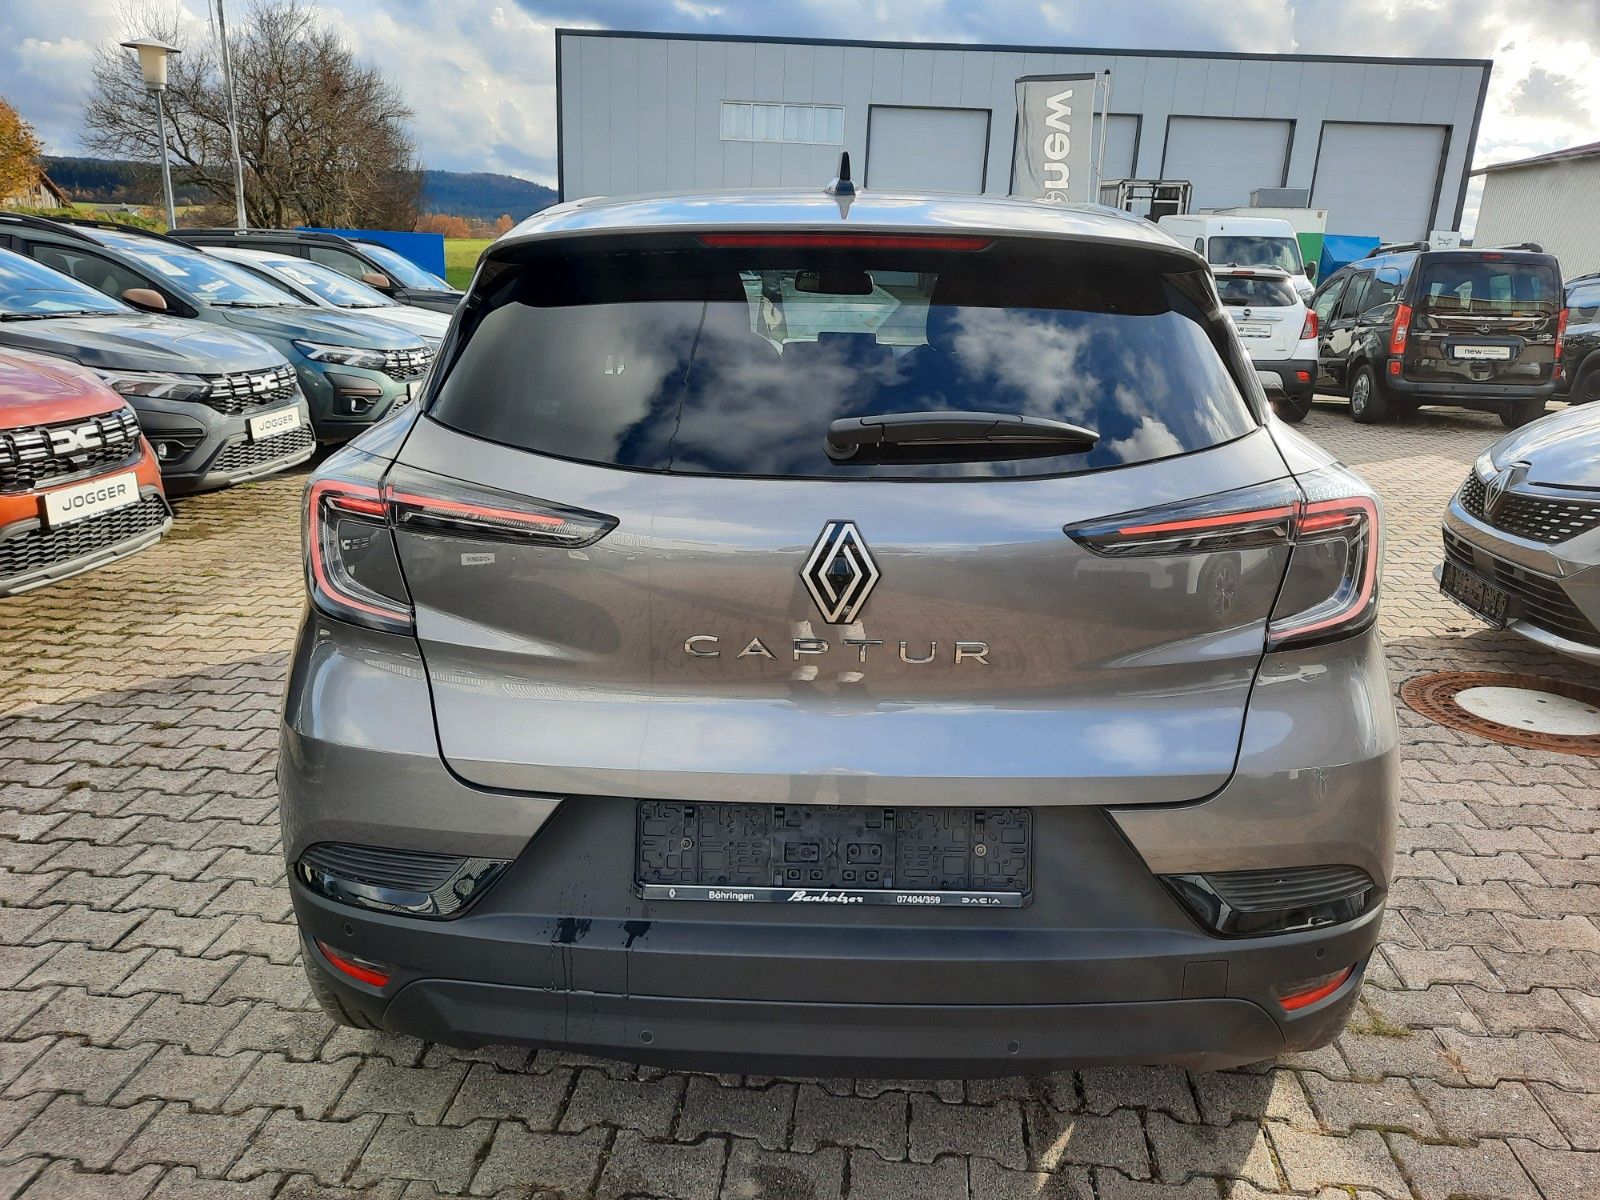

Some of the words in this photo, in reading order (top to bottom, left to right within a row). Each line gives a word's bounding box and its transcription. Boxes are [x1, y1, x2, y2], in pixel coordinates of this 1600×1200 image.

[258, 414, 294, 431] JOGGER
[61, 483, 127, 511] JOGGER
[683, 634, 990, 665] CAPTUR
[708, 890, 755, 901] Böhringen
[896, 894, 941, 905] 07404/359
[961, 897, 1001, 905] DACIA
